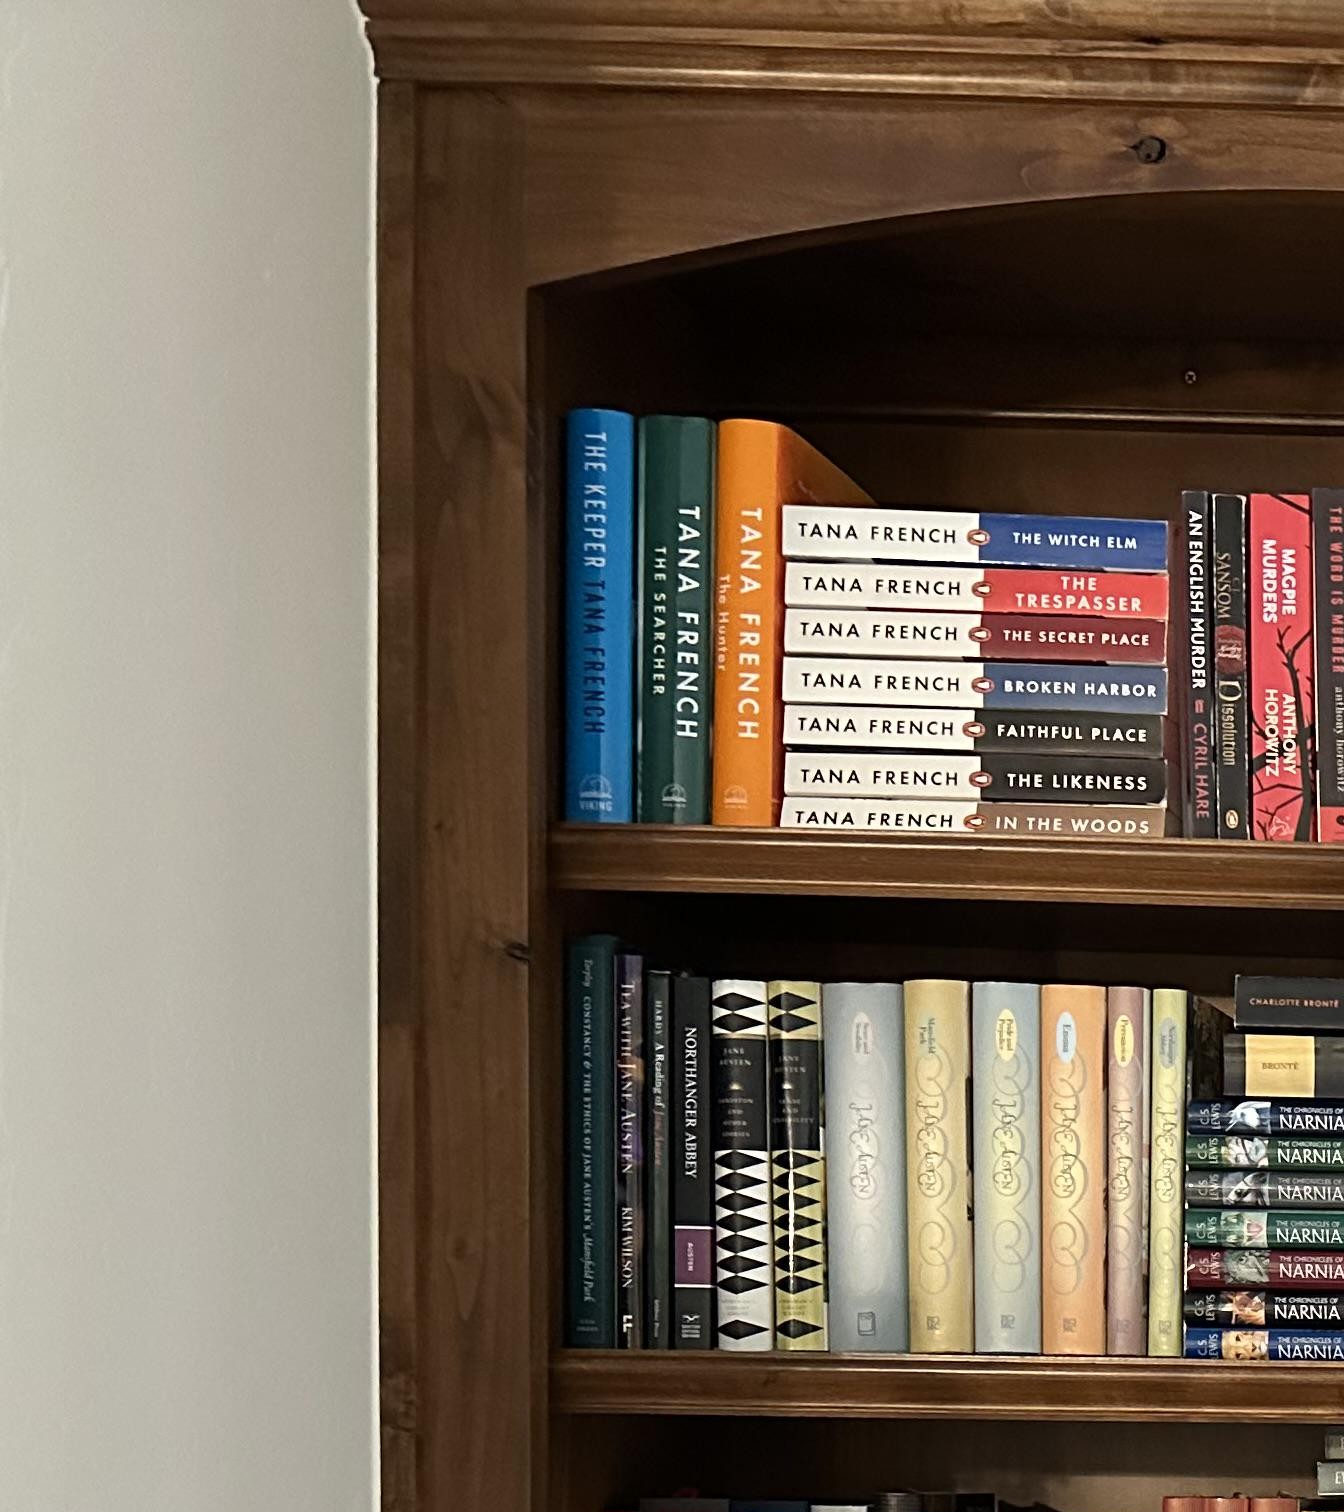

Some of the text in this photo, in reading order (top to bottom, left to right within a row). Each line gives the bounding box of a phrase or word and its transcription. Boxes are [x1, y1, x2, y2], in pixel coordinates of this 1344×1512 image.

[798, 523, 1137, 550] TANA FRENCH THE WITCH ELM
[652, 547, 666, 696] THE SEARCHER
[676, 506, 700, 739] TANA FRENCH
[1262, 539, 1277, 623] MURDERS
[1281, 548, 1296, 615] MAGPIE
[1004, 680, 1157, 697] BROKEN HARBOR
[684, 1026, 698, 1179] NORTHANGER ABBEY
